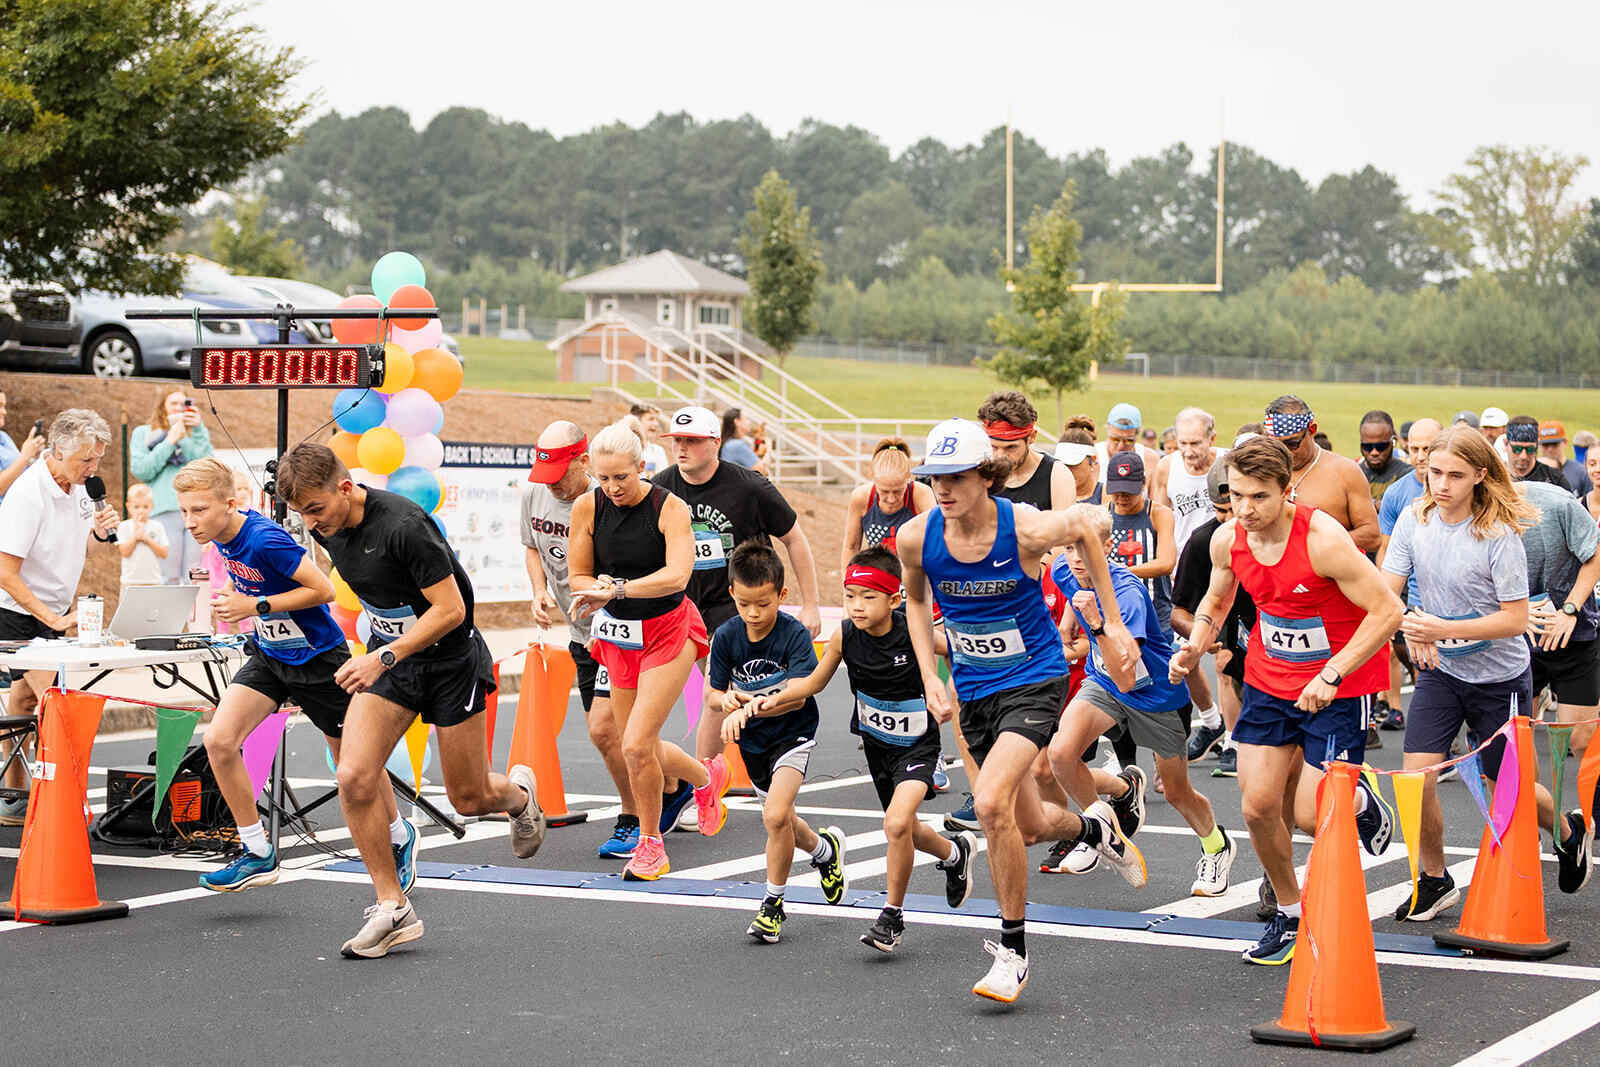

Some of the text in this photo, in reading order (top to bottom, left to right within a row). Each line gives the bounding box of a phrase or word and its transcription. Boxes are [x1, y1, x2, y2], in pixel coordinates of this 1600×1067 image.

[676, 414, 692, 425] G
[445, 446, 470, 463] BACK
[471, 446, 482, 463] TO
[482, 447, 516, 464] SCHOOL
[696, 503, 734, 532] CREEK
[549, 546, 566, 560] G
[938, 579, 1017, 597] BLAZERS
[372, 616, 404, 634] 487
[599, 622, 630, 639] 473
[960, 637, 1007, 655] 359
[1271, 631, 1311, 649] 471
[869, 712, 910, 733] 491
